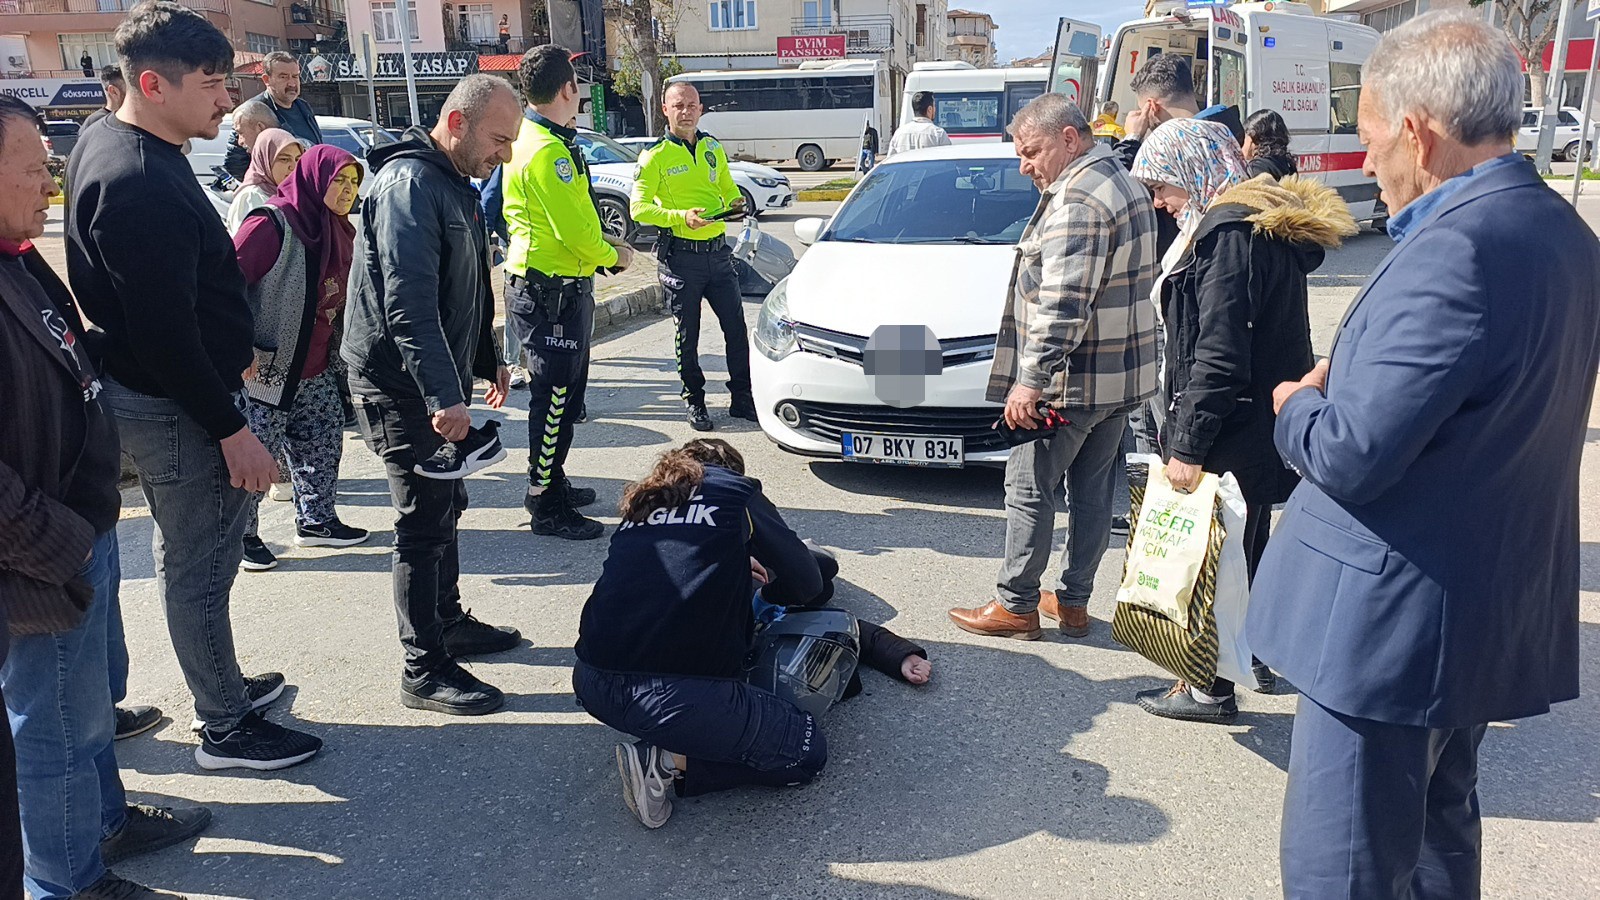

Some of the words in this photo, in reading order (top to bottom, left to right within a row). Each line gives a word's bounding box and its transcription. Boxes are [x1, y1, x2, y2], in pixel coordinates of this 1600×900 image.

[339, 56, 399, 76] SAİL
[1295, 64, 1306, 76] T.C.
[1272, 78, 1295, 93] SAĞLIK
[1297, 97, 1318, 111] SAĞLIK
[853, 436, 873, 455] 07
[883, 438, 915, 458] BKY
[925, 440, 959, 460] 834
[1146, 508, 1195, 535] DEĞER
